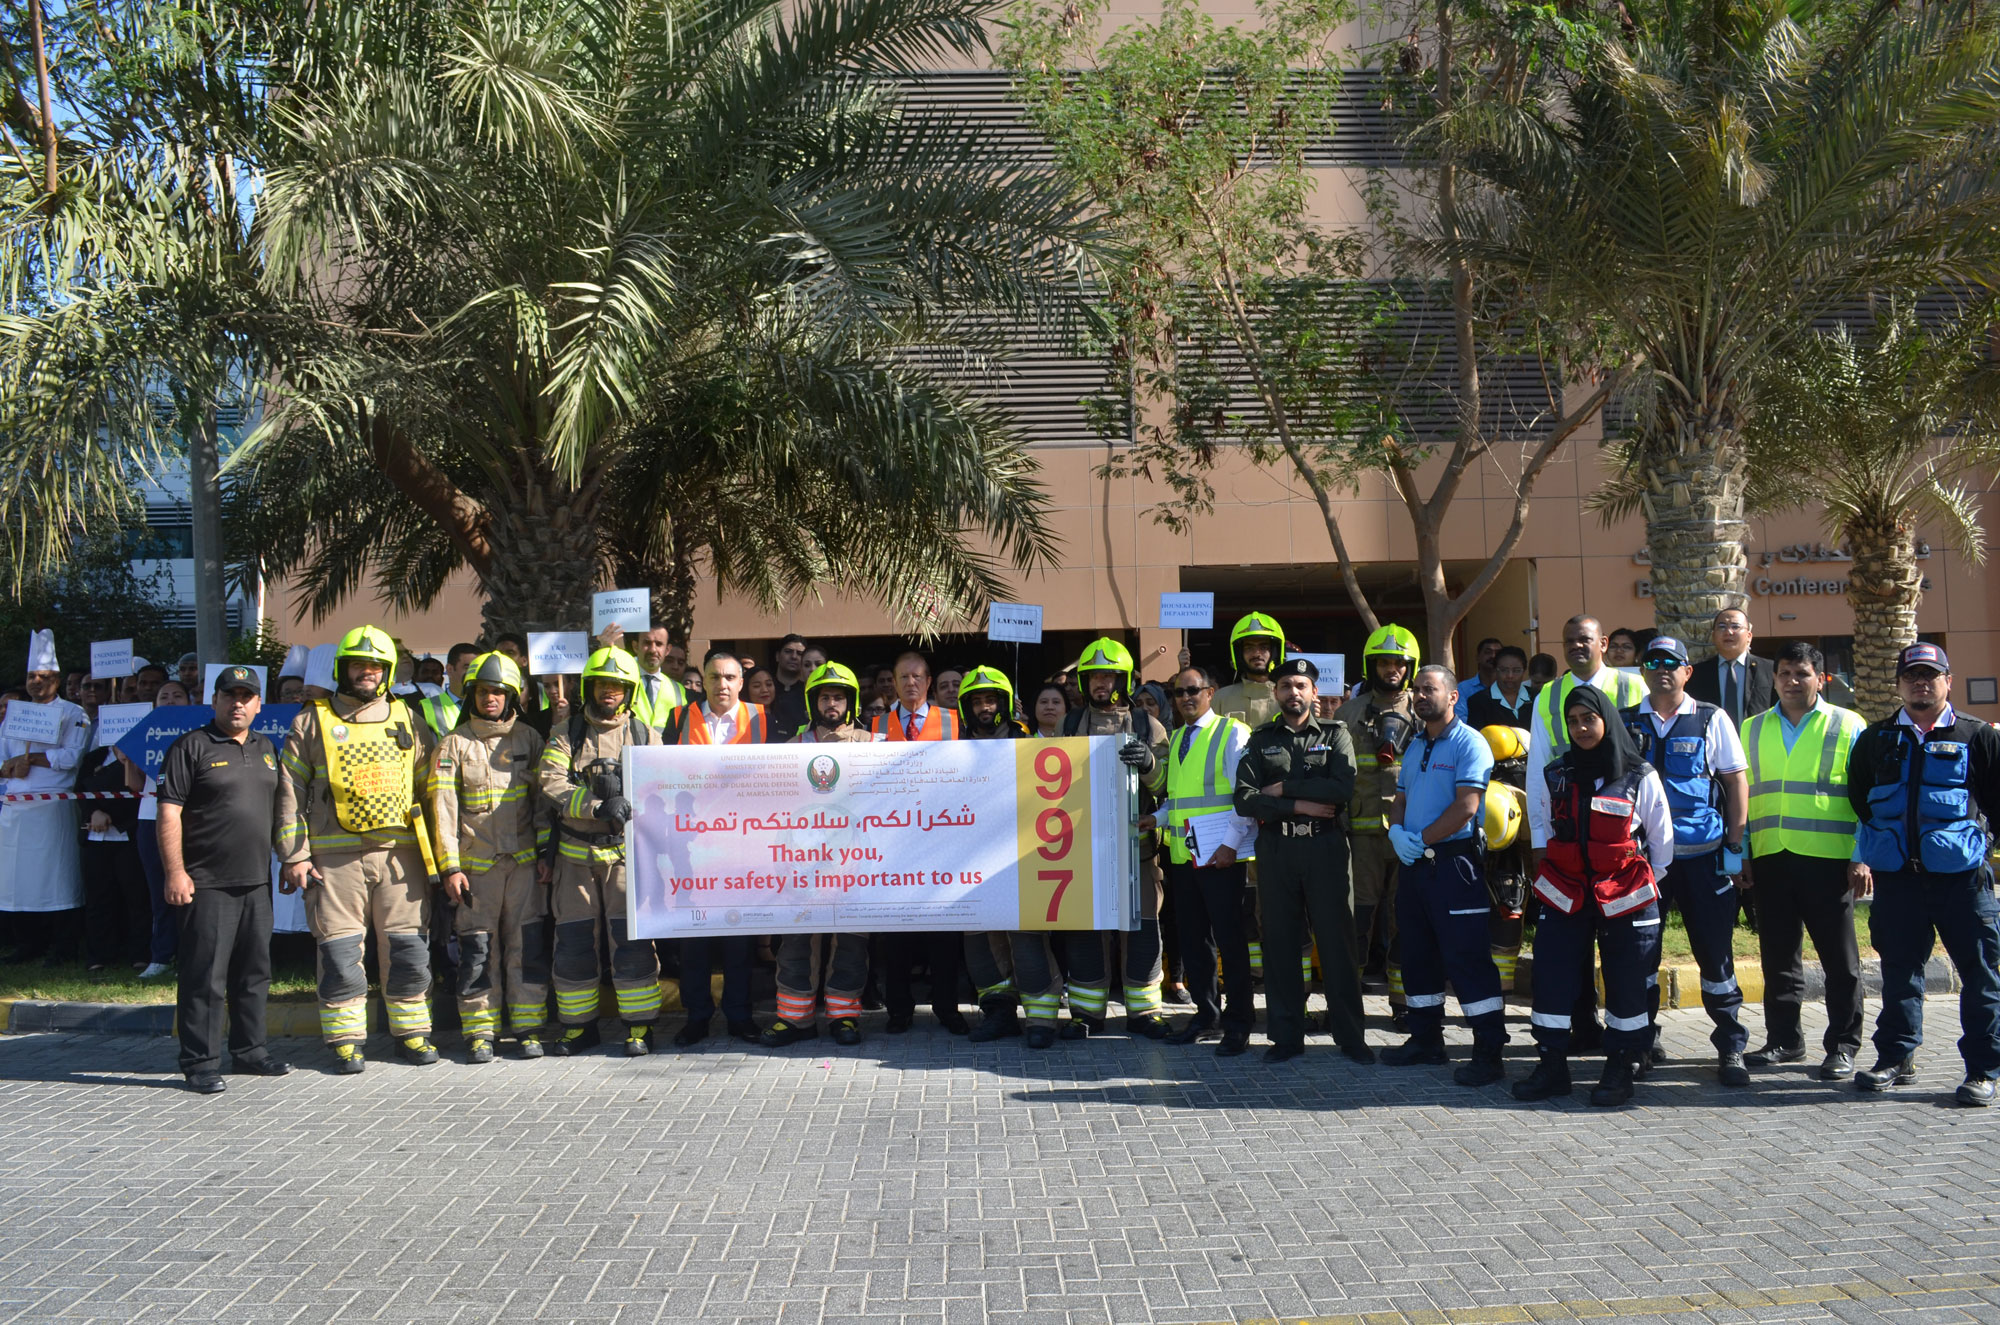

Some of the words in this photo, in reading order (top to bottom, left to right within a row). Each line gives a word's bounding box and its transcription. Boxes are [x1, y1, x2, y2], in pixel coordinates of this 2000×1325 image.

[1755, 577, 1849, 595] Confere
[598, 607, 642, 615] DEPARTMENT
[997, 618, 1033, 626] LAUNDRY
[94, 658, 129, 666] DEPARTMENT
[21, 709, 47, 717] HUMAN
[13, 716, 52, 726] RESOURCES
[8, 724, 54, 735] DEPARTMENT
[359, 785, 400, 795] OFFICER
[675, 811, 737, 833] تهمنا
[743, 811, 848, 835] سلامتكم
[767, 843, 833, 862] Thank
[839, 847, 883, 865] you,
[670, 877, 718, 895] your
[724, 871, 787, 893] safety
[793, 870, 808, 888] is
[815, 870, 925, 892] important
[931, 870, 953, 885] to
[960, 871, 982, 884] us
[690, 909, 707, 920] 10X
